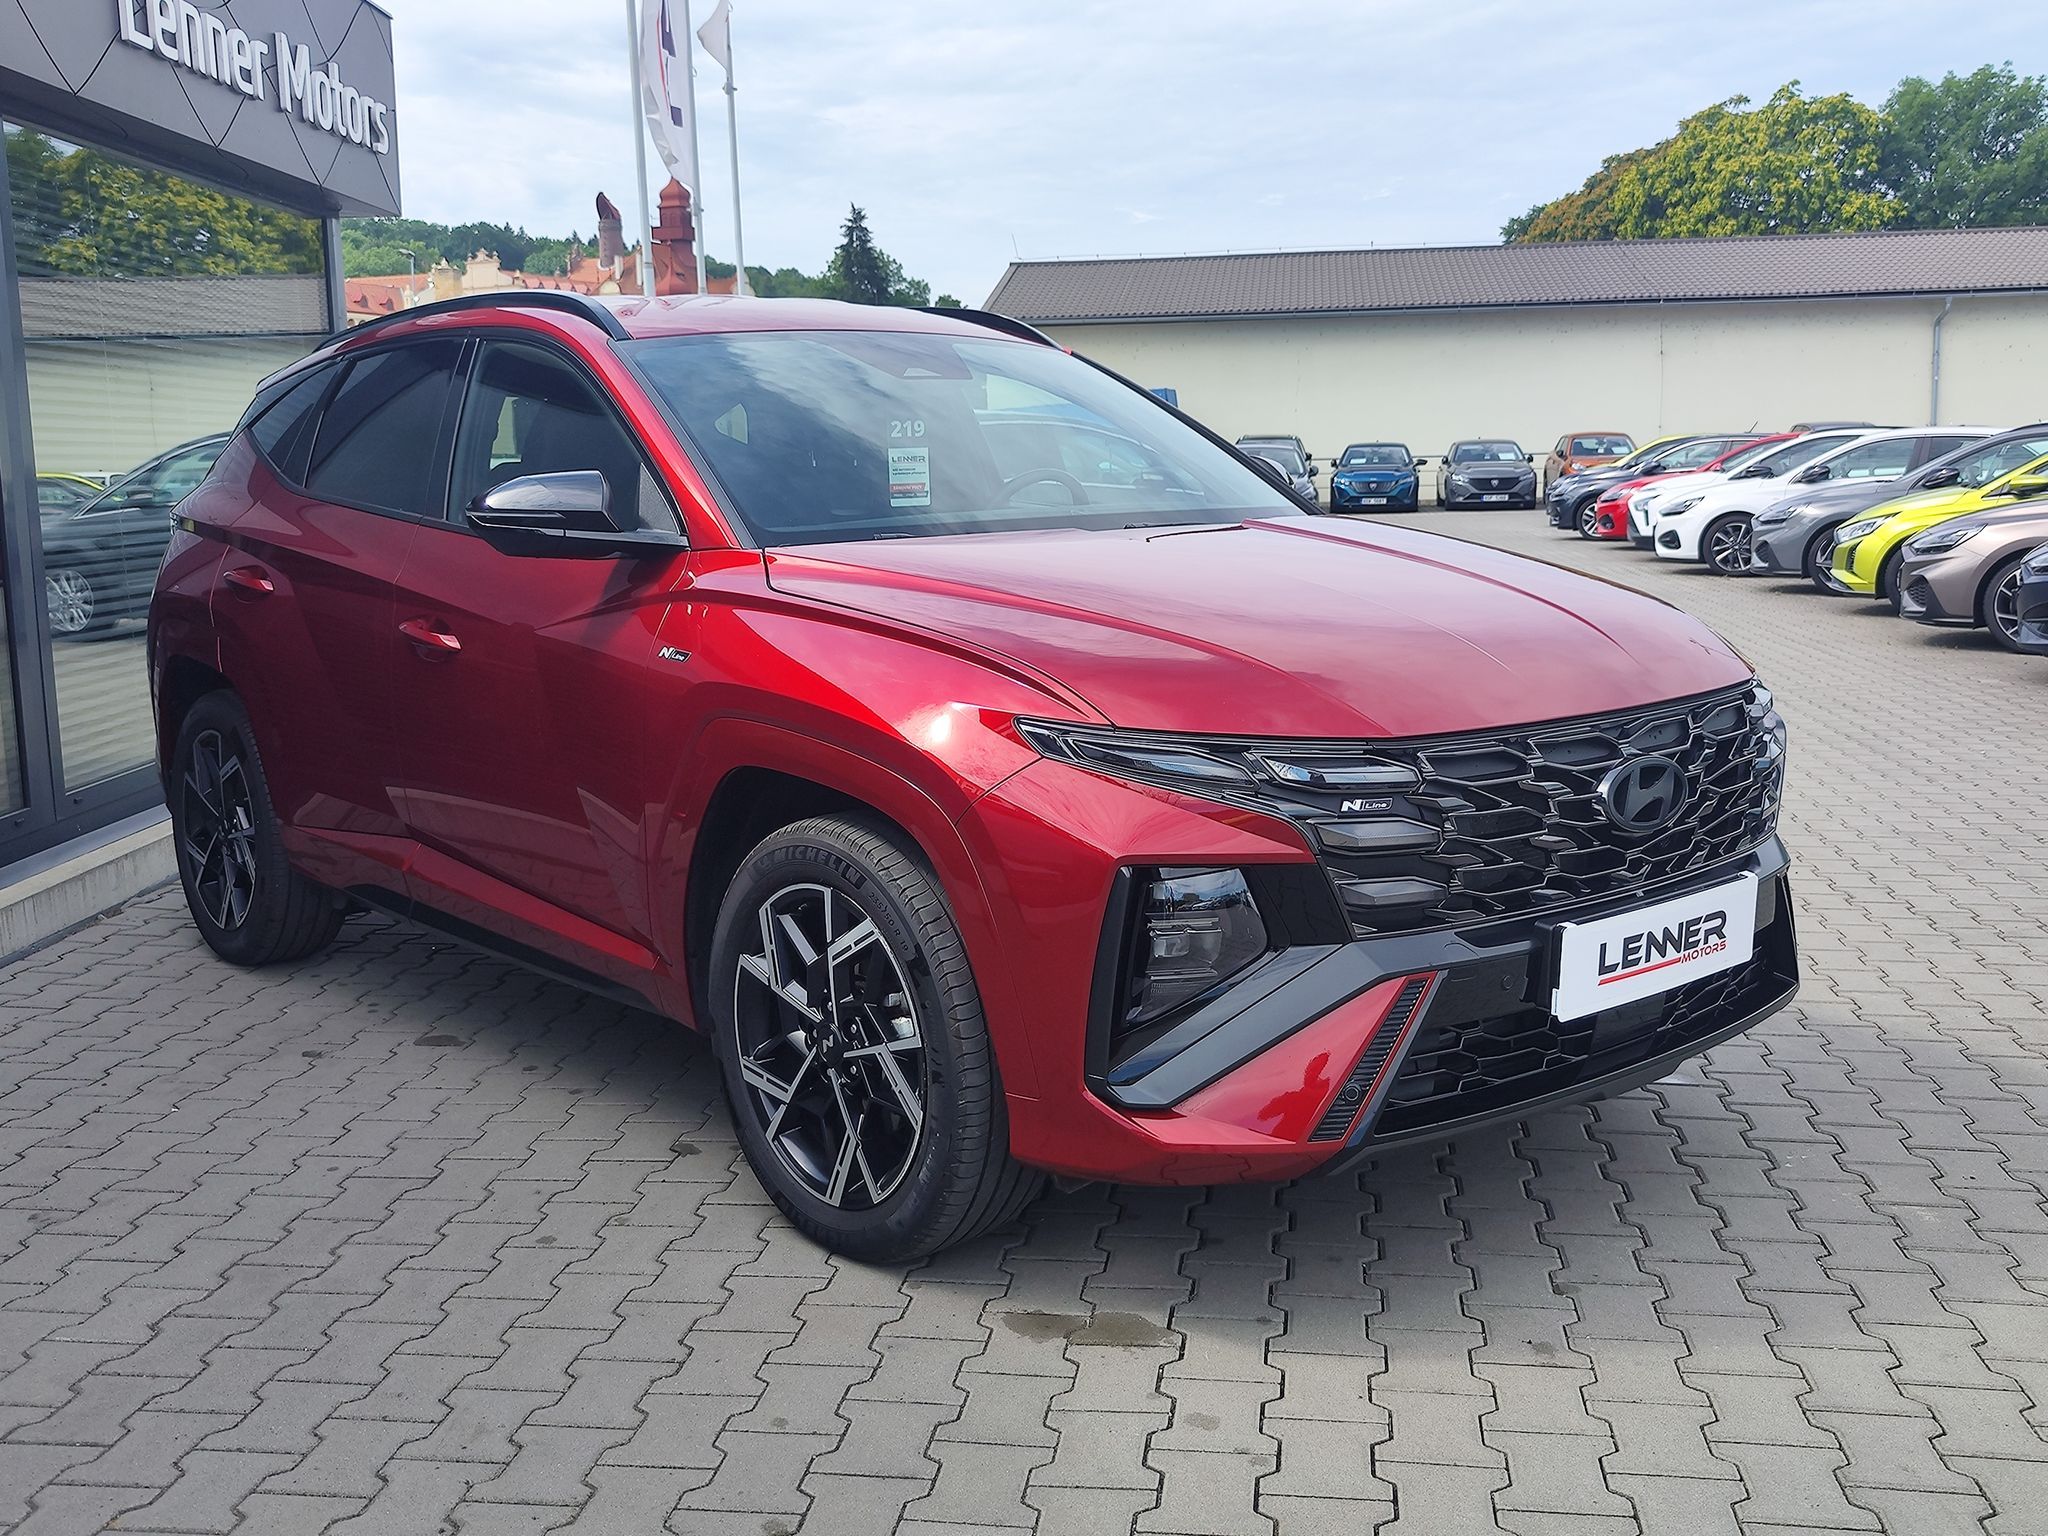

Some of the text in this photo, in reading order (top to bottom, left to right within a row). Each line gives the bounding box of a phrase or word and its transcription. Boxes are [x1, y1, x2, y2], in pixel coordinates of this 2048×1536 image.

[118, 0, 390, 155] Lenner Motors
[890, 420, 925, 438] 219
[891, 455, 926, 463] LENNER
[658, 646, 674, 659] N
[1340, 799, 1362, 812] N
[774, 846, 860, 883] MICHELIN
[1598, 910, 1727, 976] LENNER
[1681, 940, 1728, 964] MOTORS
